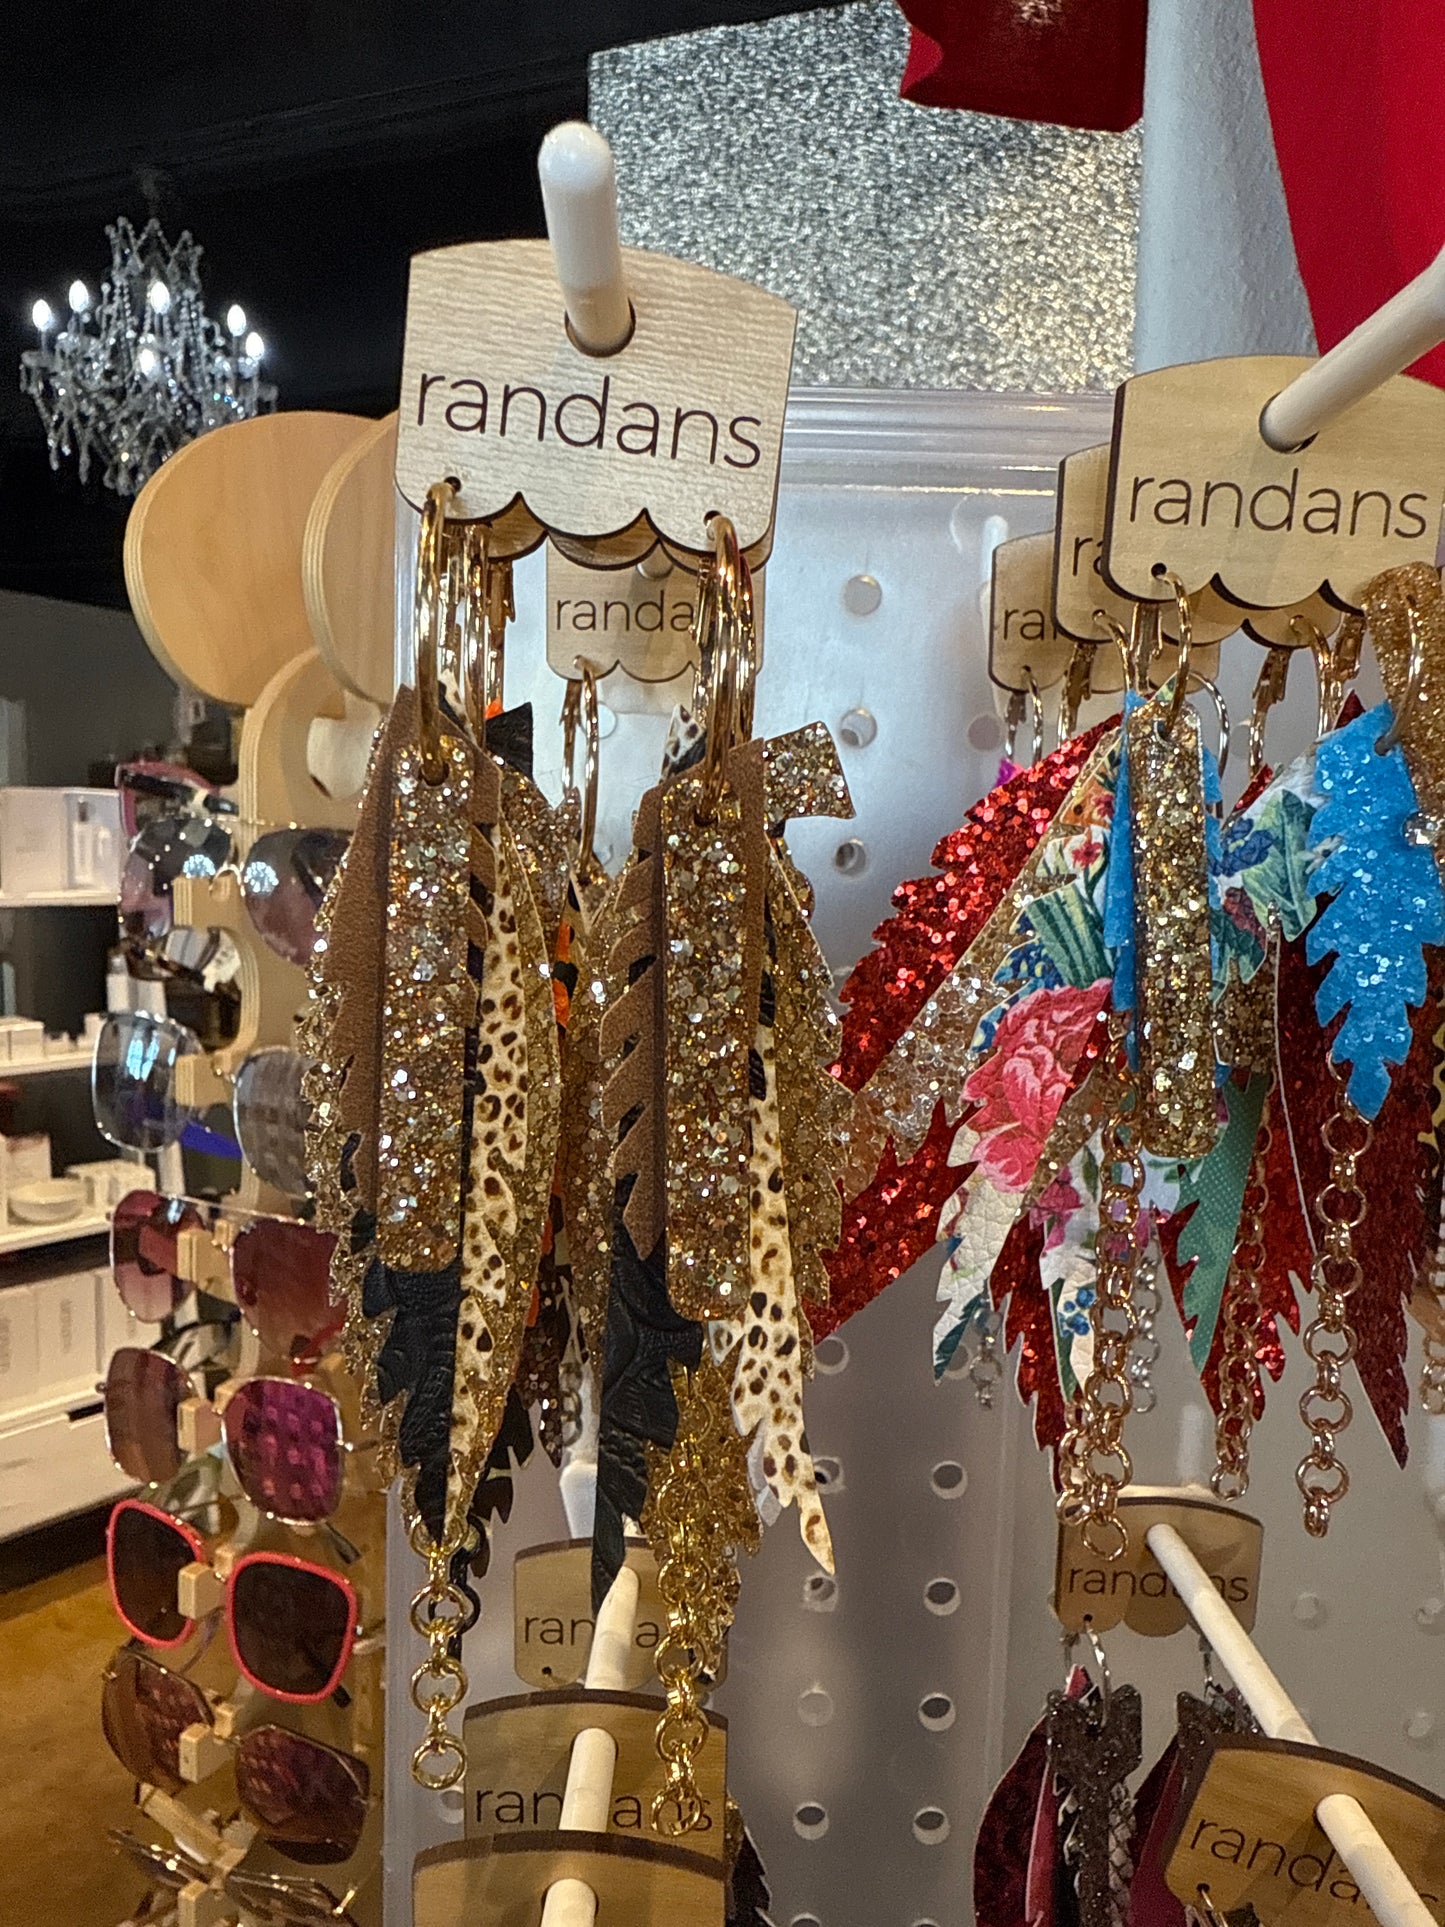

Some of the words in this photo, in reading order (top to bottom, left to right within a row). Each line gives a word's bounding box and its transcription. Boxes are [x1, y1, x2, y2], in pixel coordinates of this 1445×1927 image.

[417, 372, 762, 468] randans
[1129, 467, 1428, 538] randans
[556, 589, 696, 632] randa
[1068, 1567, 1250, 1603] randns
[523, 1616, 660, 1649] rana
[1189, 1818, 1439, 1910] randa
